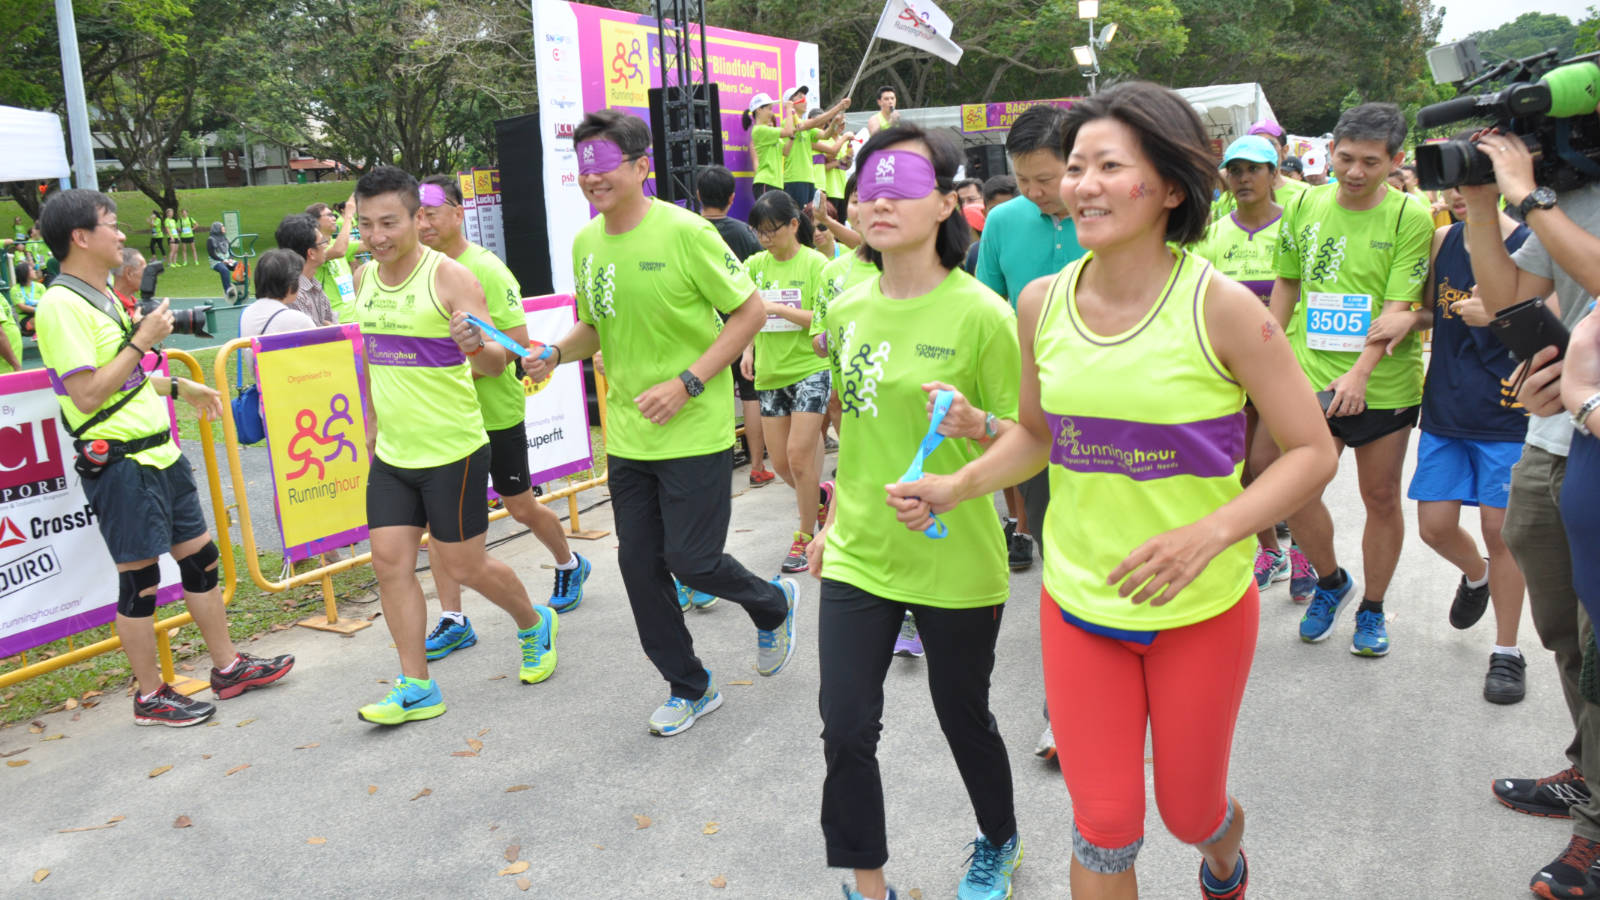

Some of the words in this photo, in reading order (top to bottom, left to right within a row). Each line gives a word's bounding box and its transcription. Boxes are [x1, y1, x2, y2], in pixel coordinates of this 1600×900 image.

[761, 62, 777, 81] Run
[1310, 310, 1363, 332] 3505
[2, 405, 15, 416] By
[287, 475, 361, 505] Runninghour
[30, 503, 98, 540] CrossF
